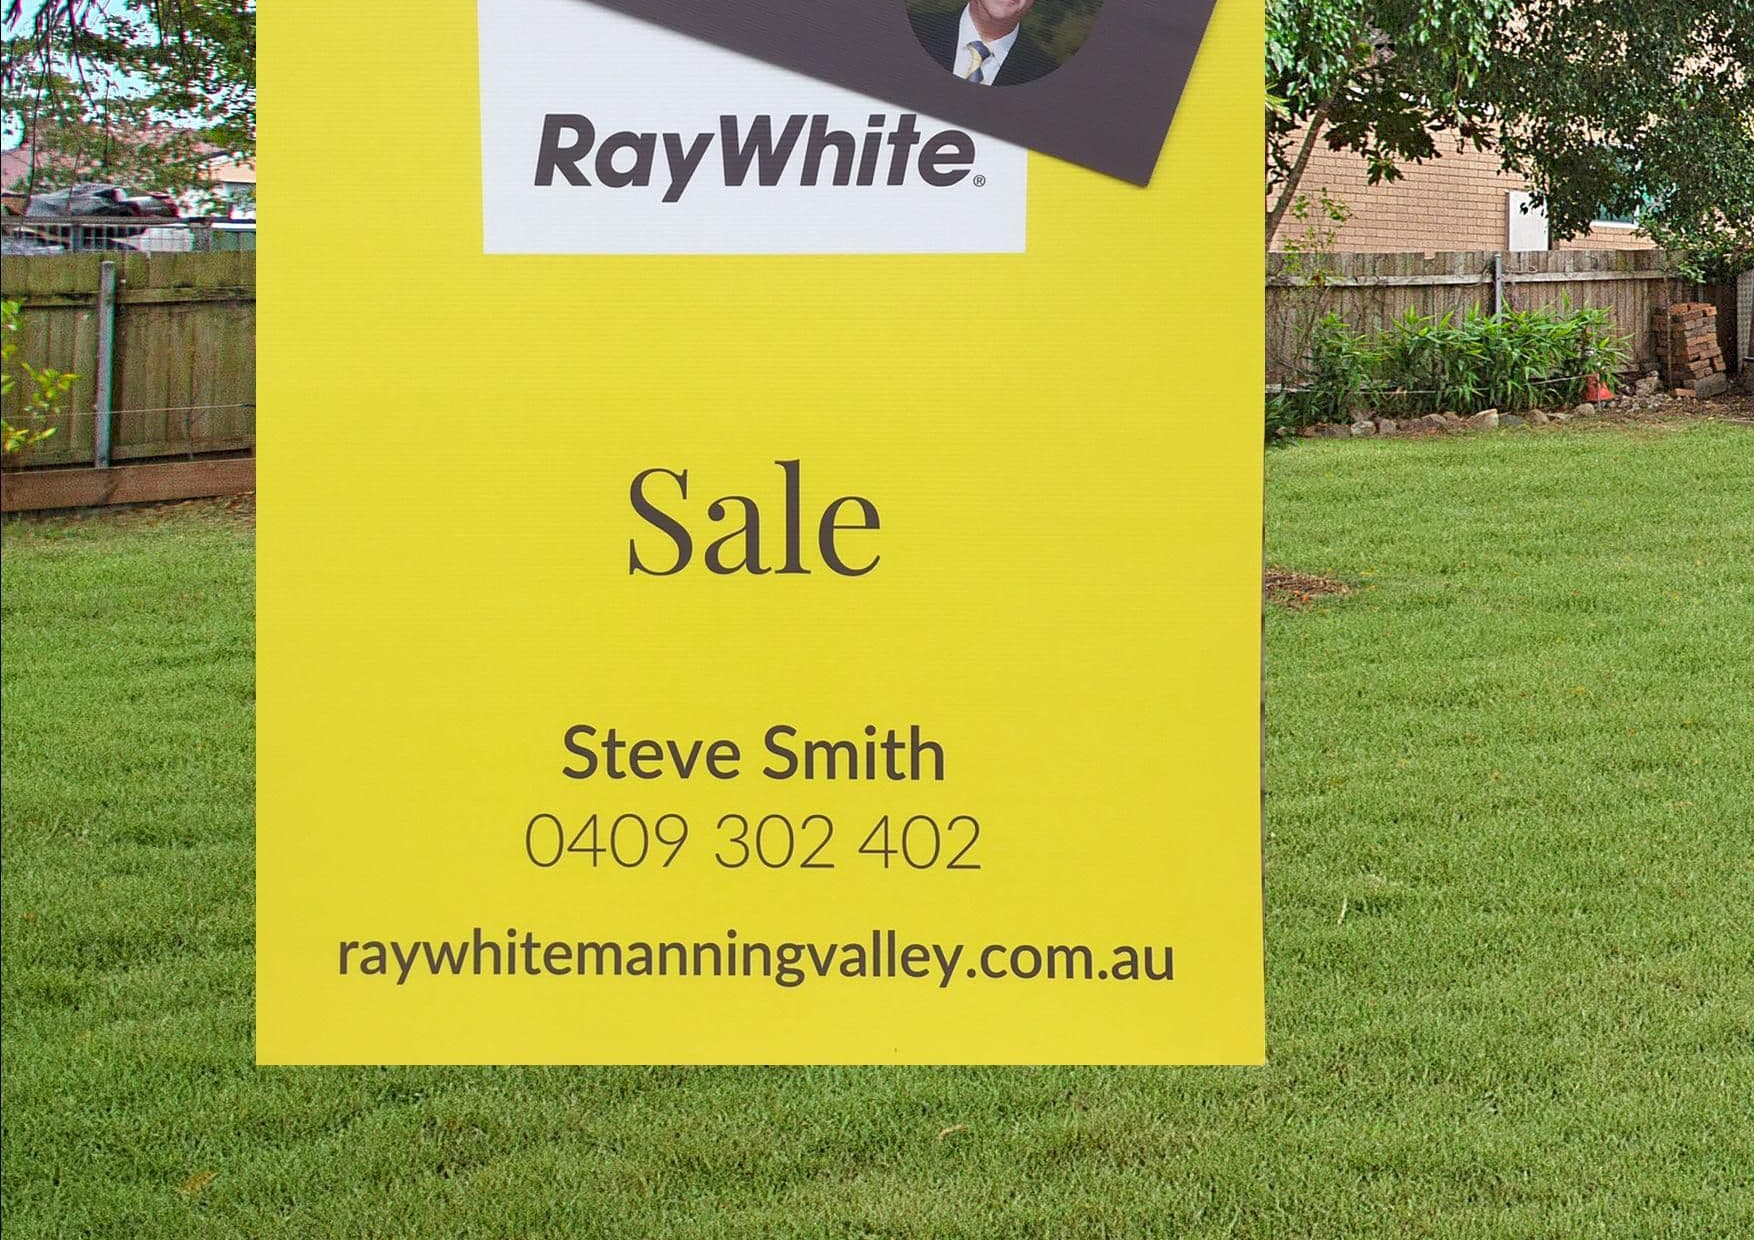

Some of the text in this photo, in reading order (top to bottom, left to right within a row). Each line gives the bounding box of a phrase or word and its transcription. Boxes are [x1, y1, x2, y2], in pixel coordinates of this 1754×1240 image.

[628, 458, 881, 577] Sale
[562, 724, 945, 781] Steve Smith
[525, 813, 982, 870] 0409 302 402
[339, 927, 1174, 989] raywhitemanningvalley.com.au
